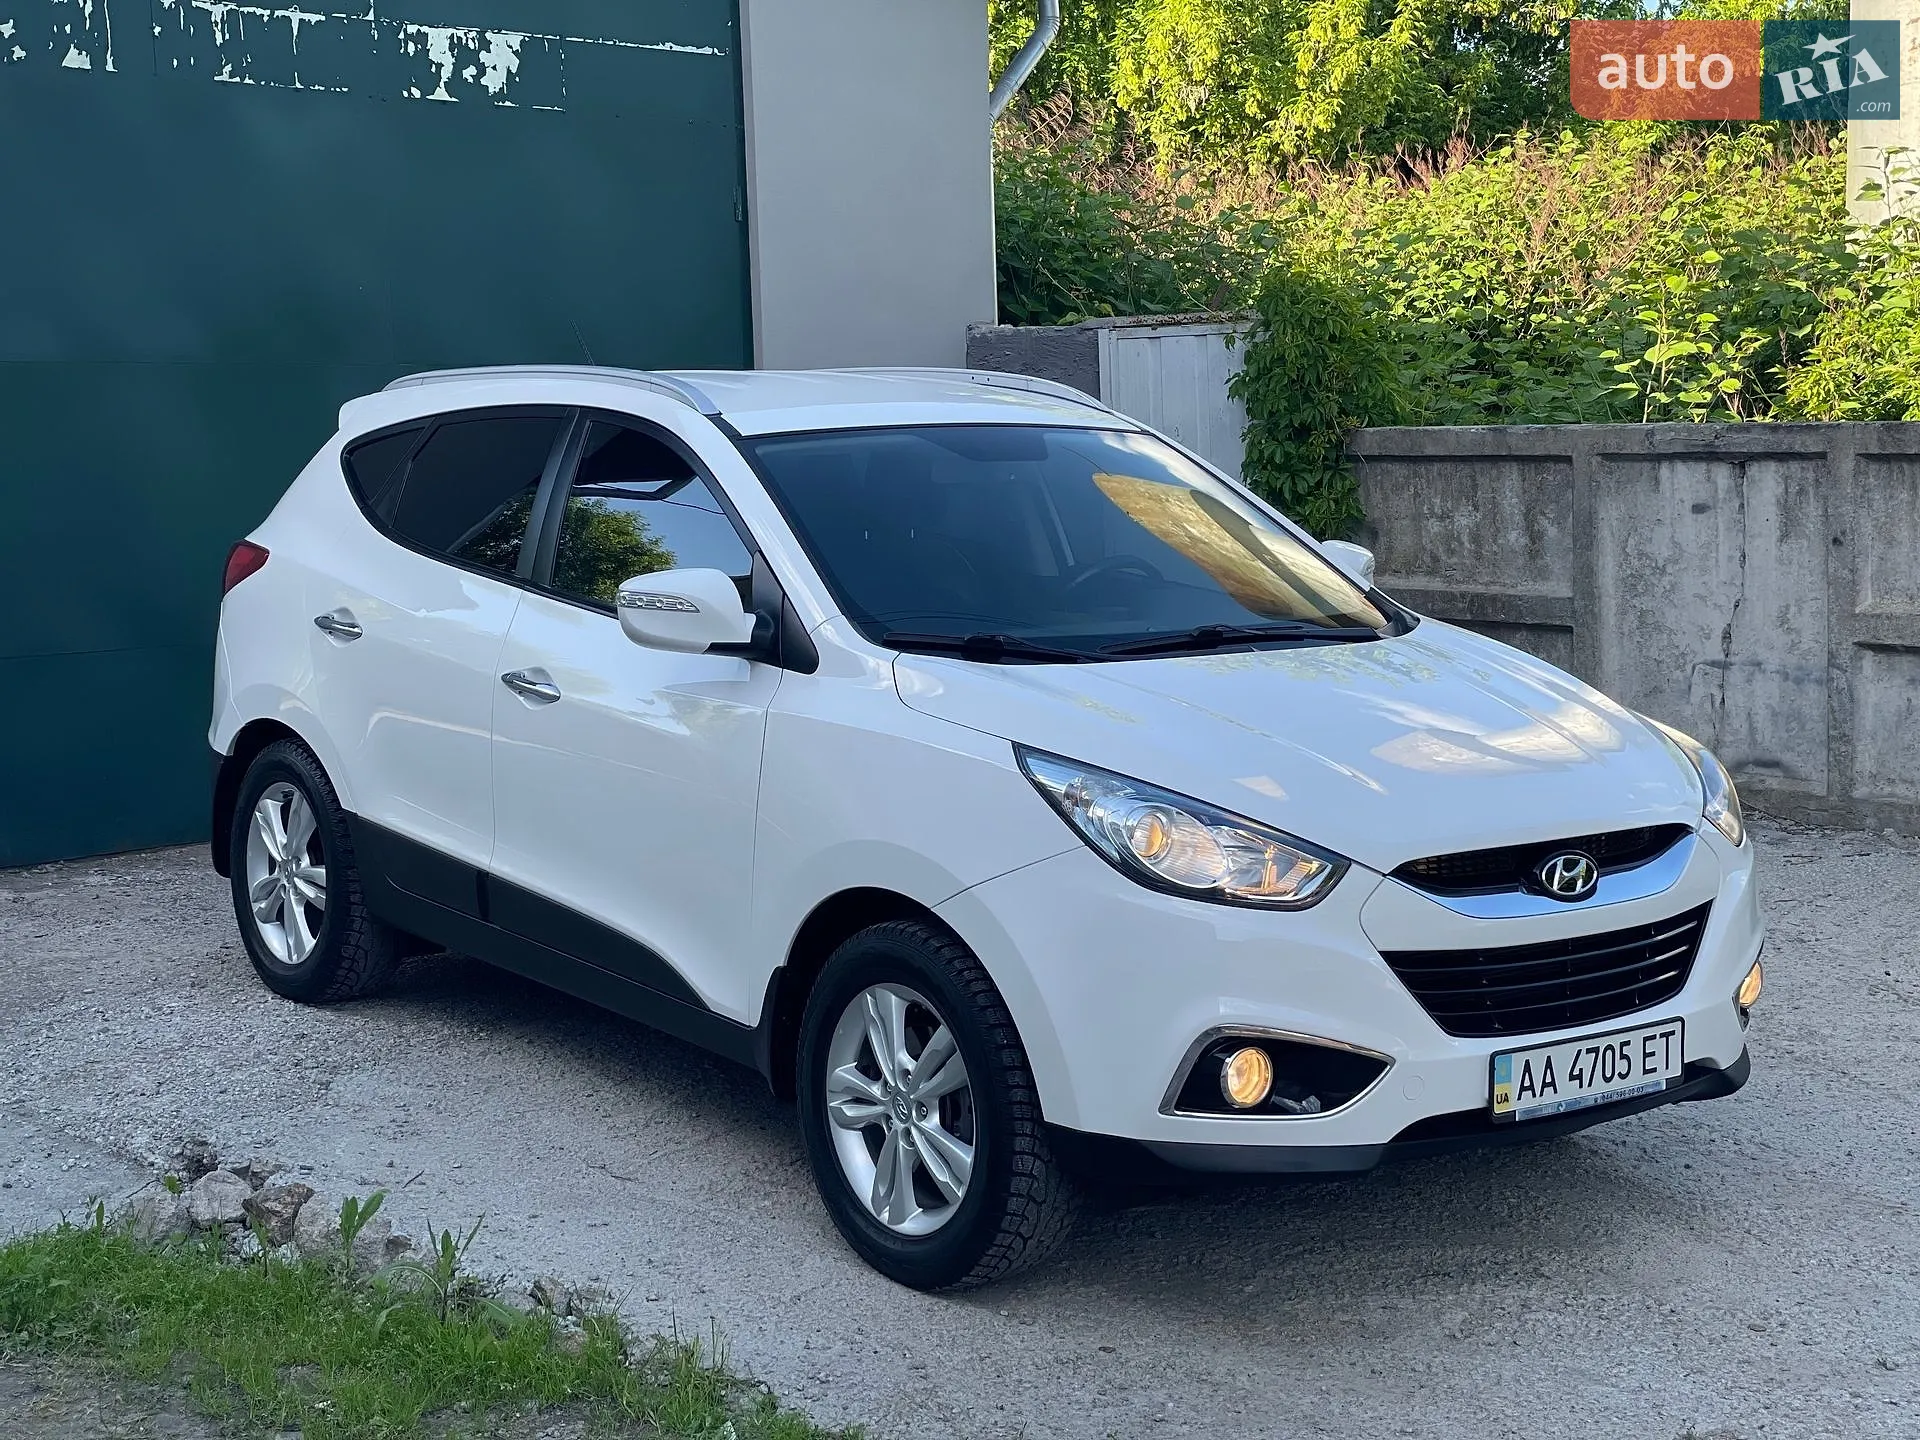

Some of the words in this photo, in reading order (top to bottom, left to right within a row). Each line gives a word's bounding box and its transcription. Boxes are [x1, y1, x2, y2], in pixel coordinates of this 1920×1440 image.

[1517, 1055, 1558, 1101] AA
[1568, 1040, 1632, 1089] 4705
[1642, 1029, 1676, 1076] ET
[1496, 1092, 1510, 1104] UA
